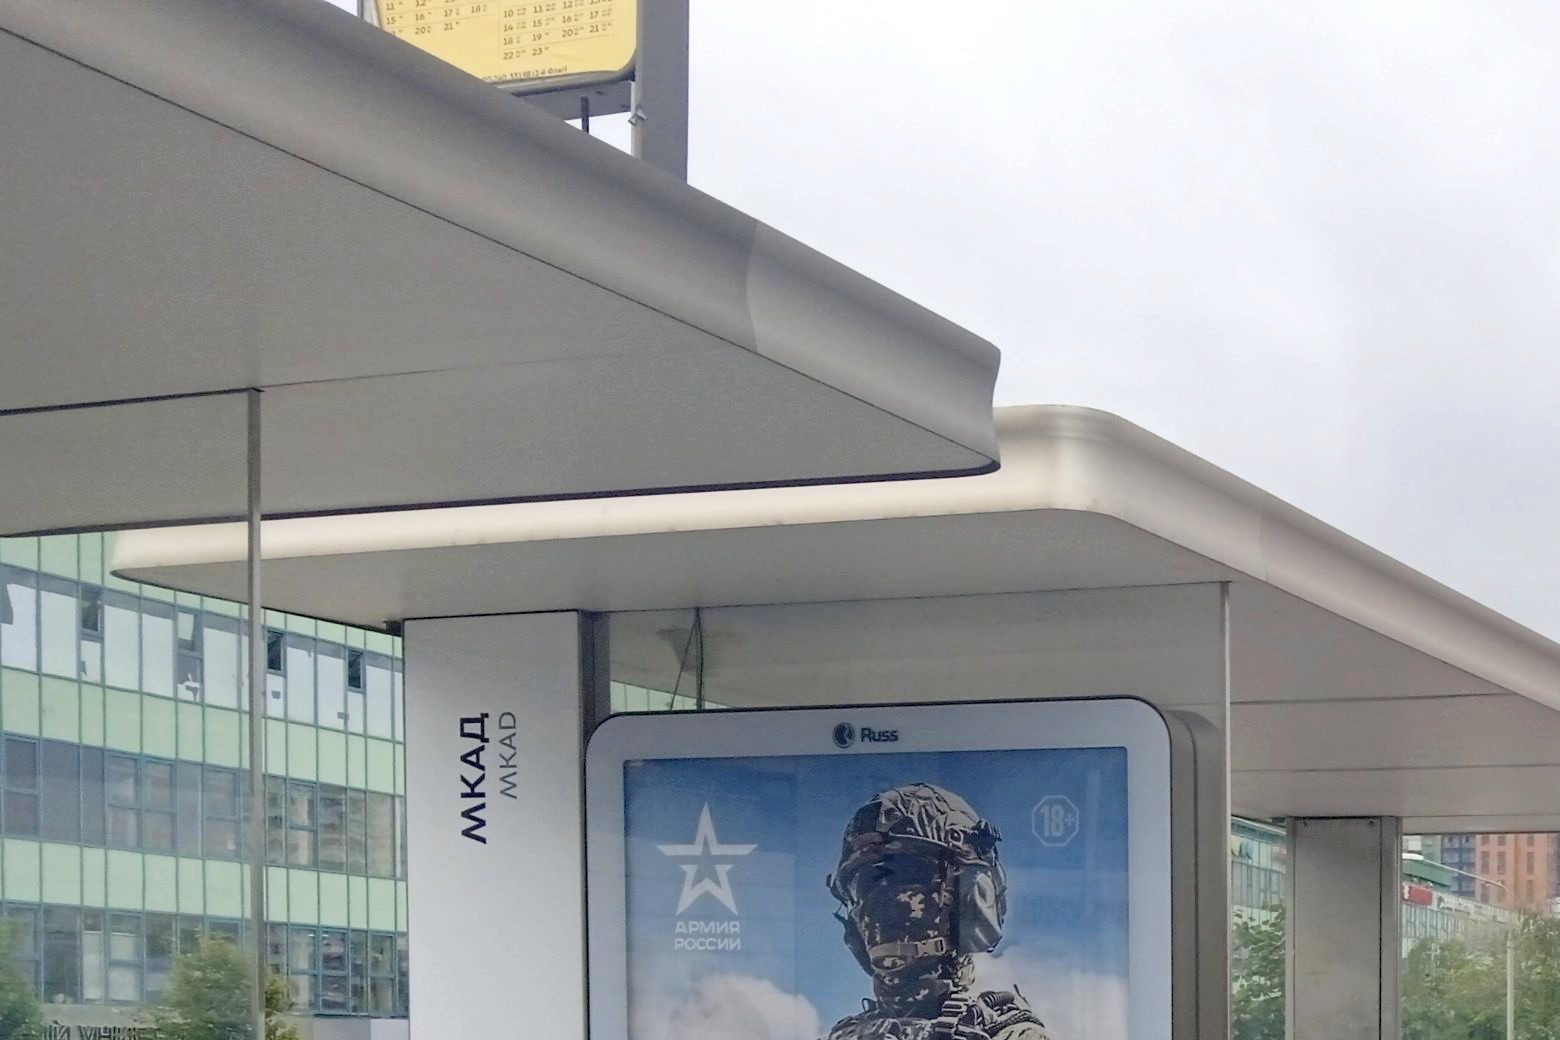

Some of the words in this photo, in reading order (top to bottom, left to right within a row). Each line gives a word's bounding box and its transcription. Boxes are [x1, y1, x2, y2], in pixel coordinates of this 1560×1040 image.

[860, 727, 899, 743] Russ
[498, 711, 518, 800] MKAD
[460, 712, 490, 845] МКАД
[1040, 804, 1076, 838] 18+
[674, 920, 741, 934] АРМИЯ
[673, 937, 741, 951] РОССИИ
